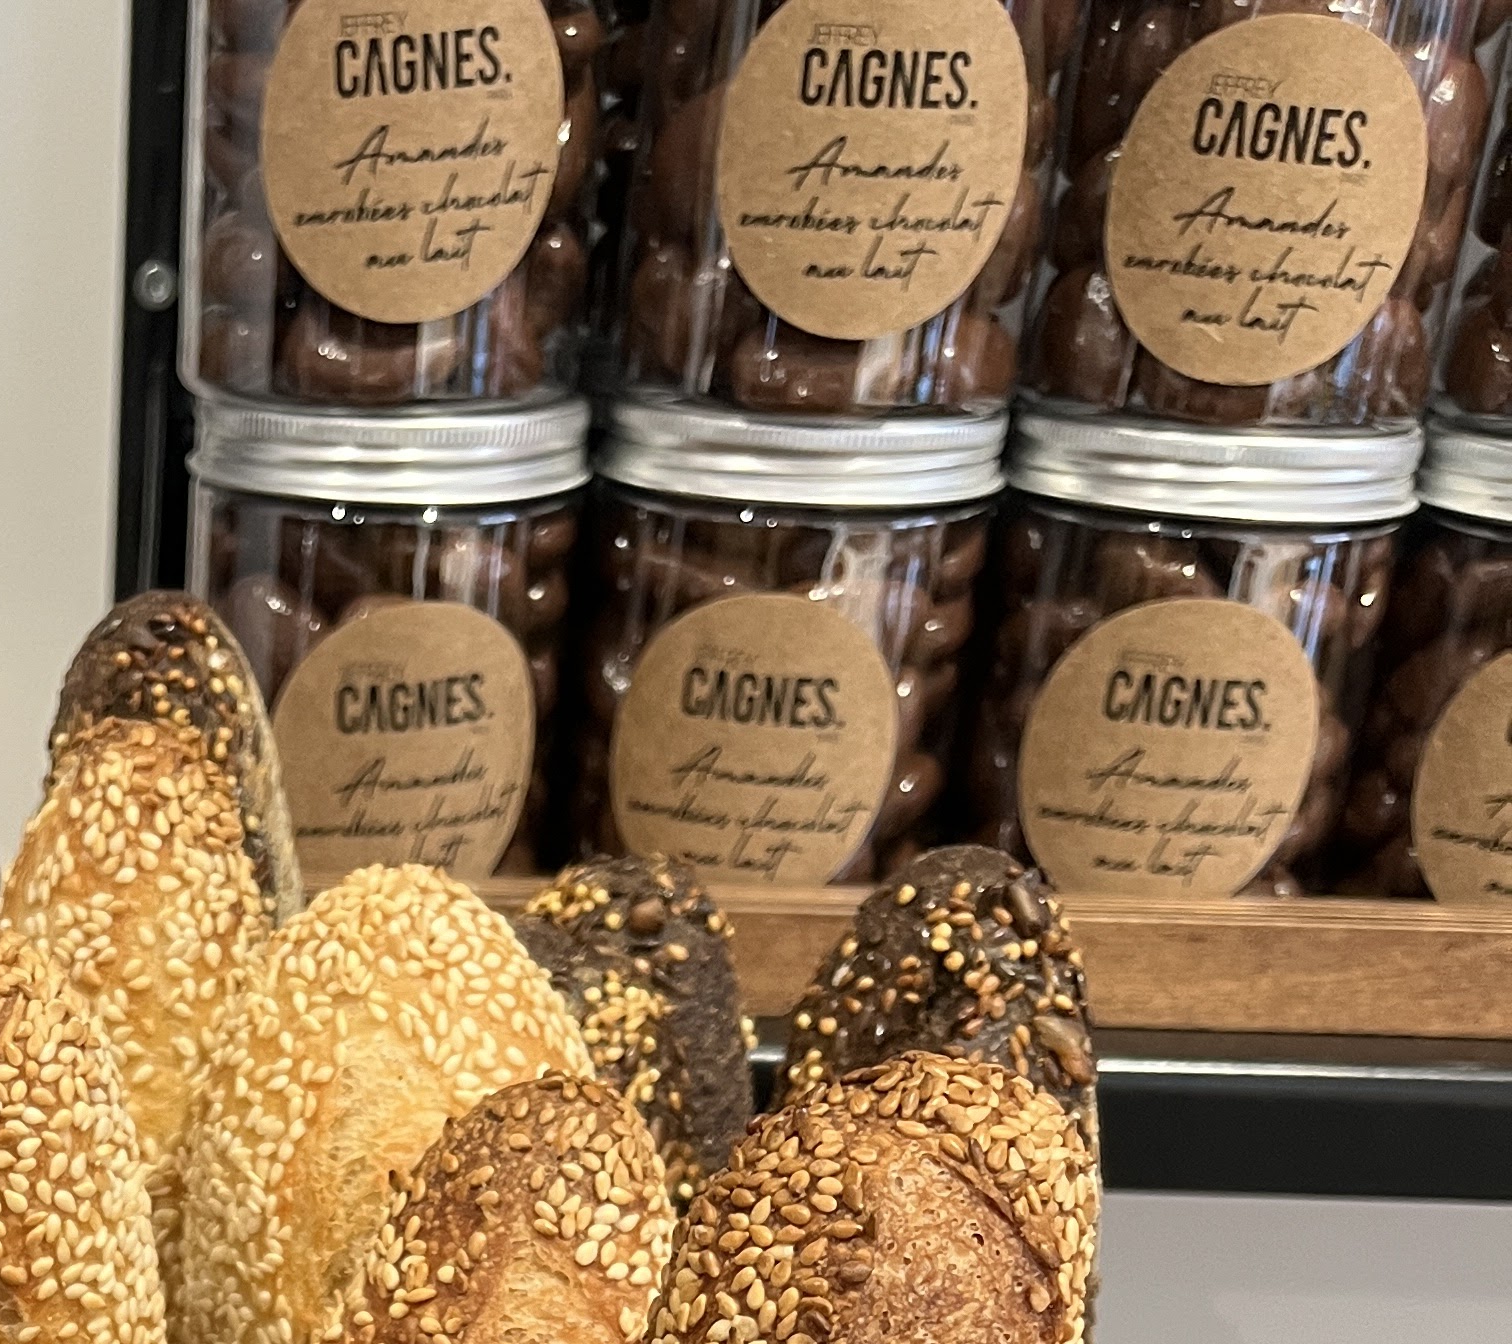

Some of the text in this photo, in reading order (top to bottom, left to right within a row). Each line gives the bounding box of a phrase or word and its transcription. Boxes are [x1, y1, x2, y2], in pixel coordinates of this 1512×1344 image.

[336, 26, 514, 99] CAGNES.
[800, 47, 980, 110] CAGNES.
[1192, 97, 1374, 170] CAGNES.
